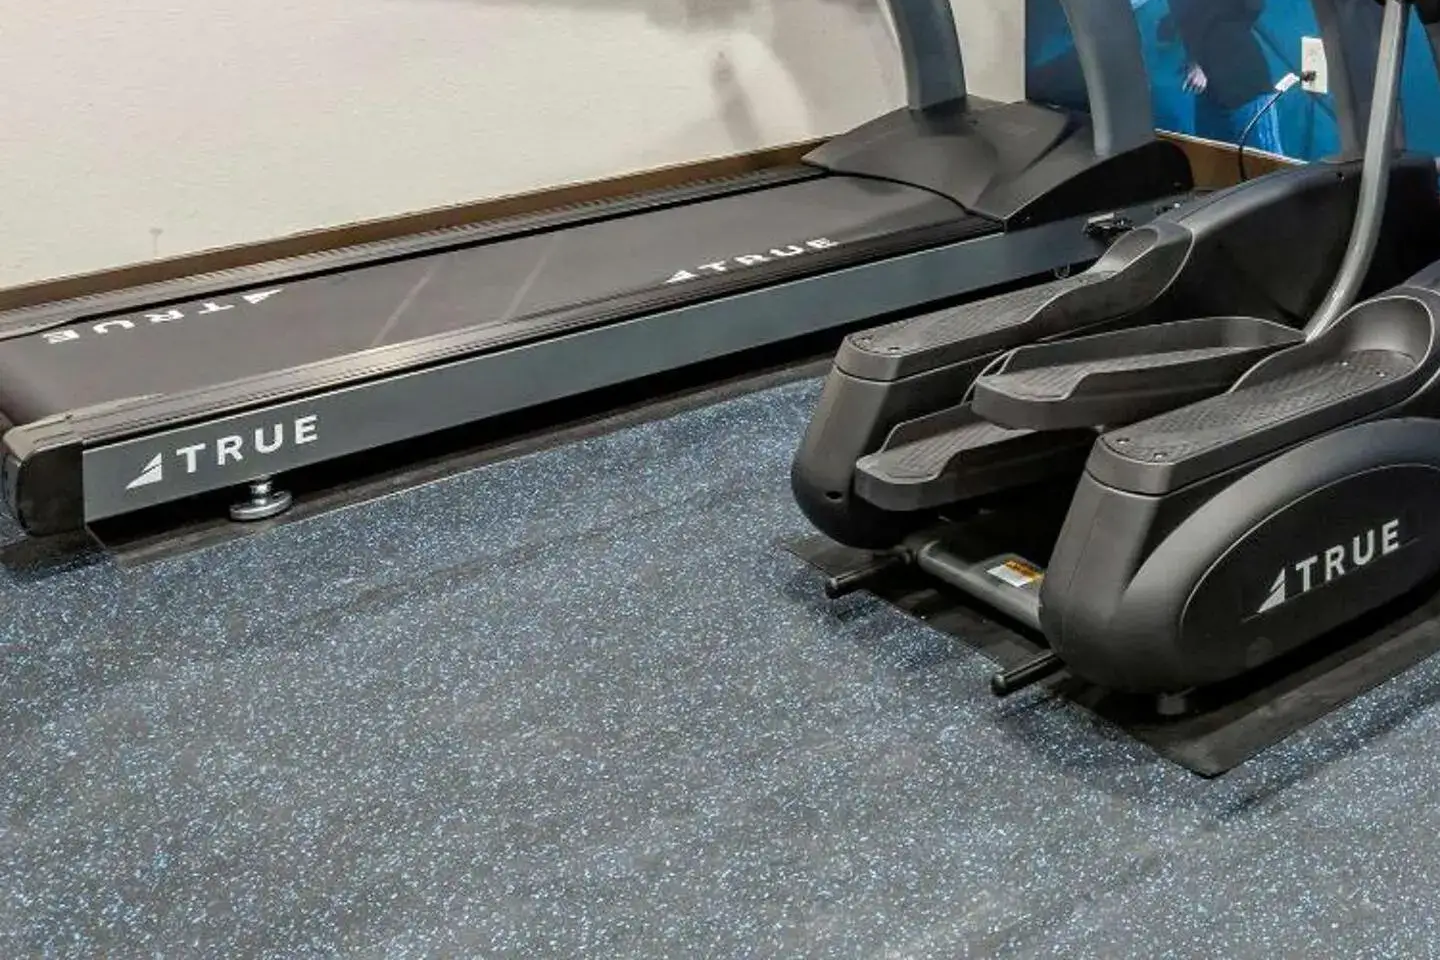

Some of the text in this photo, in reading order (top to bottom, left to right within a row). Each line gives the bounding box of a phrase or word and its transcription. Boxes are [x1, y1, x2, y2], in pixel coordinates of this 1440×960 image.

[697, 237, 840, 272] TRUE
[43, 302, 235, 344] TRUE
[176, 414, 318, 473] TRUE
[1295, 519, 1399, 592] TRUE
